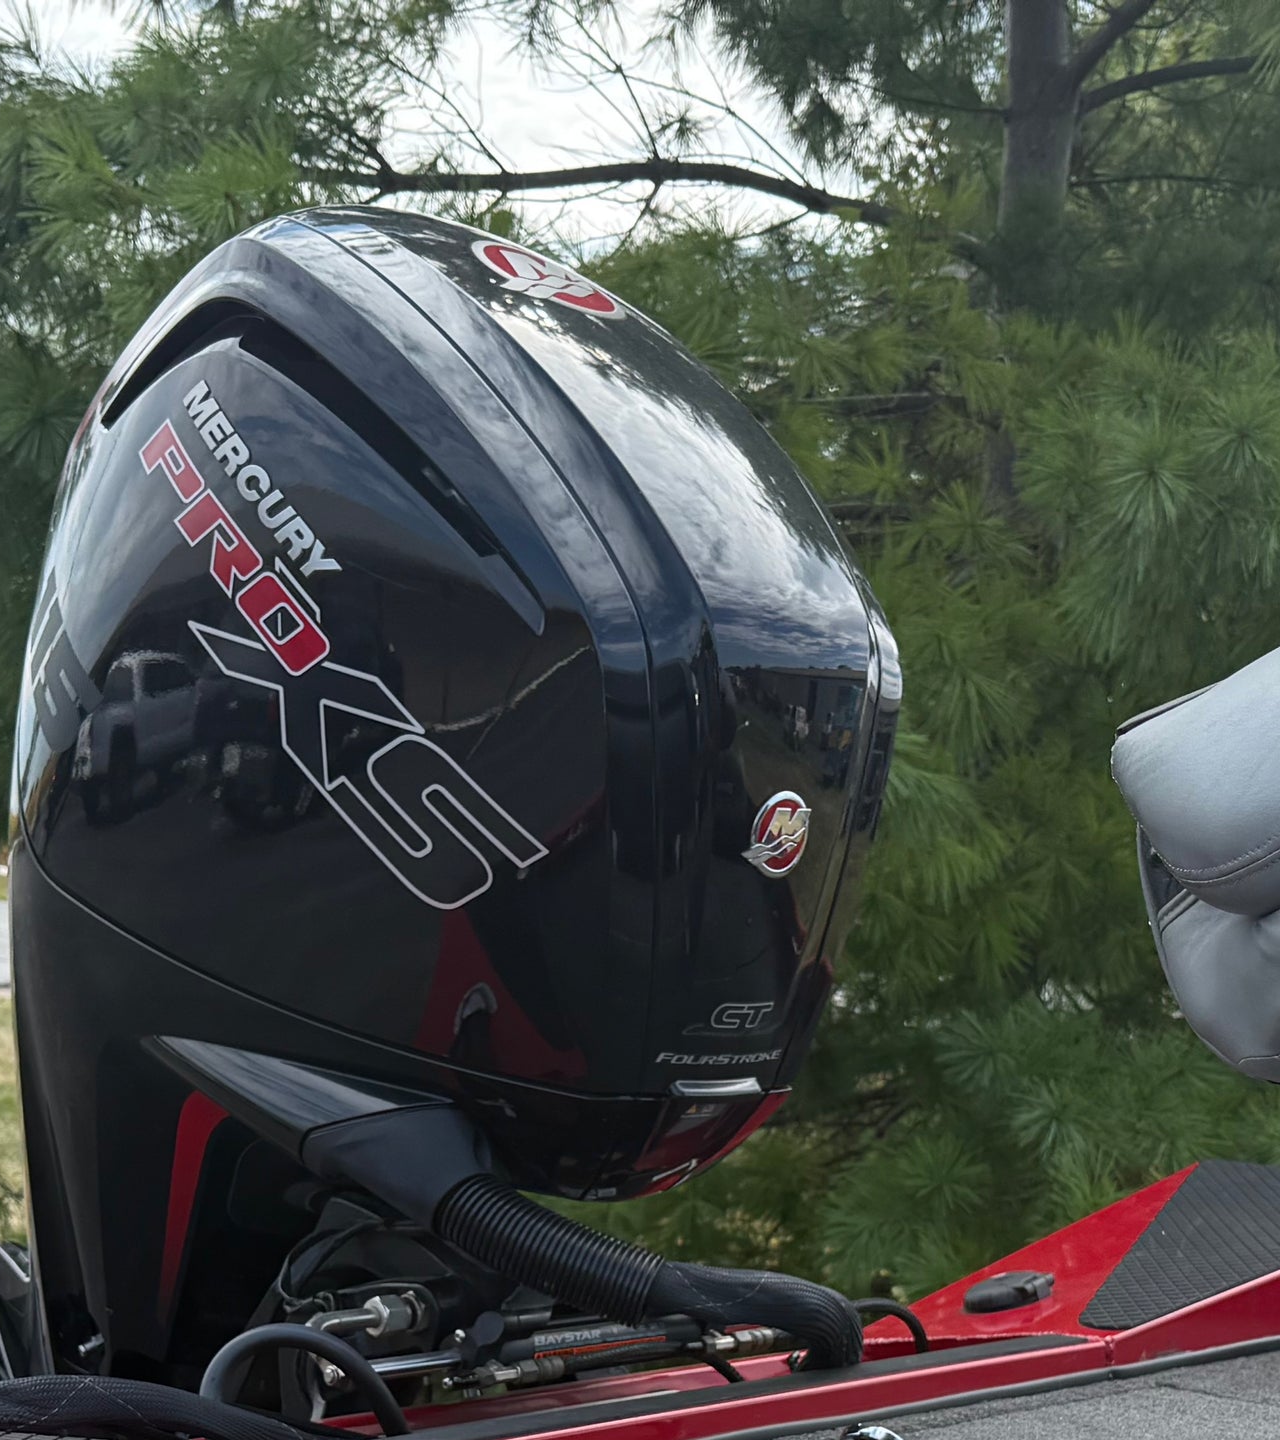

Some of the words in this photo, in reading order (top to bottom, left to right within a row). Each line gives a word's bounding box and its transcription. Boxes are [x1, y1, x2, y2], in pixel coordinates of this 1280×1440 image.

[138, 418, 330, 676] PRO
[182, 379, 343, 578] MERCURY
[188, 556, 549, 910] XS
[655, 1049, 782, 1065] FOURSTROKE
[534, 1328, 601, 1346] BAYSTAR
